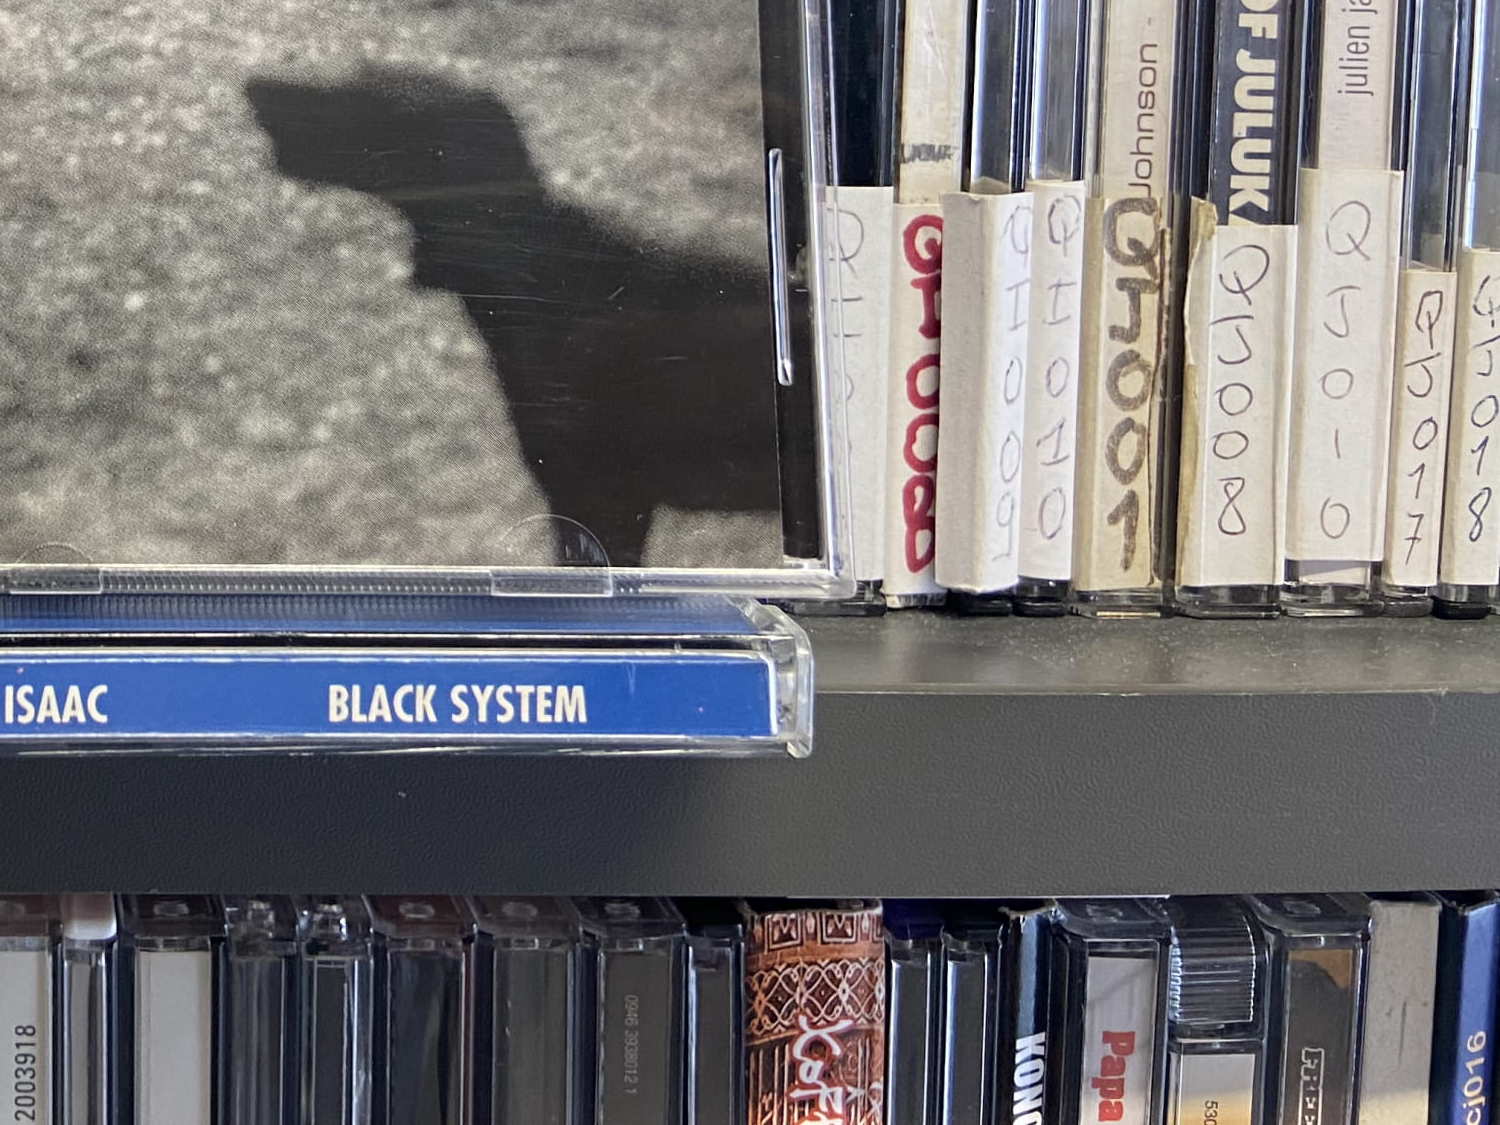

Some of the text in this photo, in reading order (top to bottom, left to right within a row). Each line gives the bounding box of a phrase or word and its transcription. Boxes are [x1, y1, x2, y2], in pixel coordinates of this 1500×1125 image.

[1338, 24, 1375, 97] julien
[1128, 41, 1159, 198] Johnson
[3, 684, 110, 725] ISAAC
[327, 684, 588, 724] BLACK SYSTEM
[14, 1025, 37, 1122] 2003918
[1091, 1030, 1136, 1122] Papa
